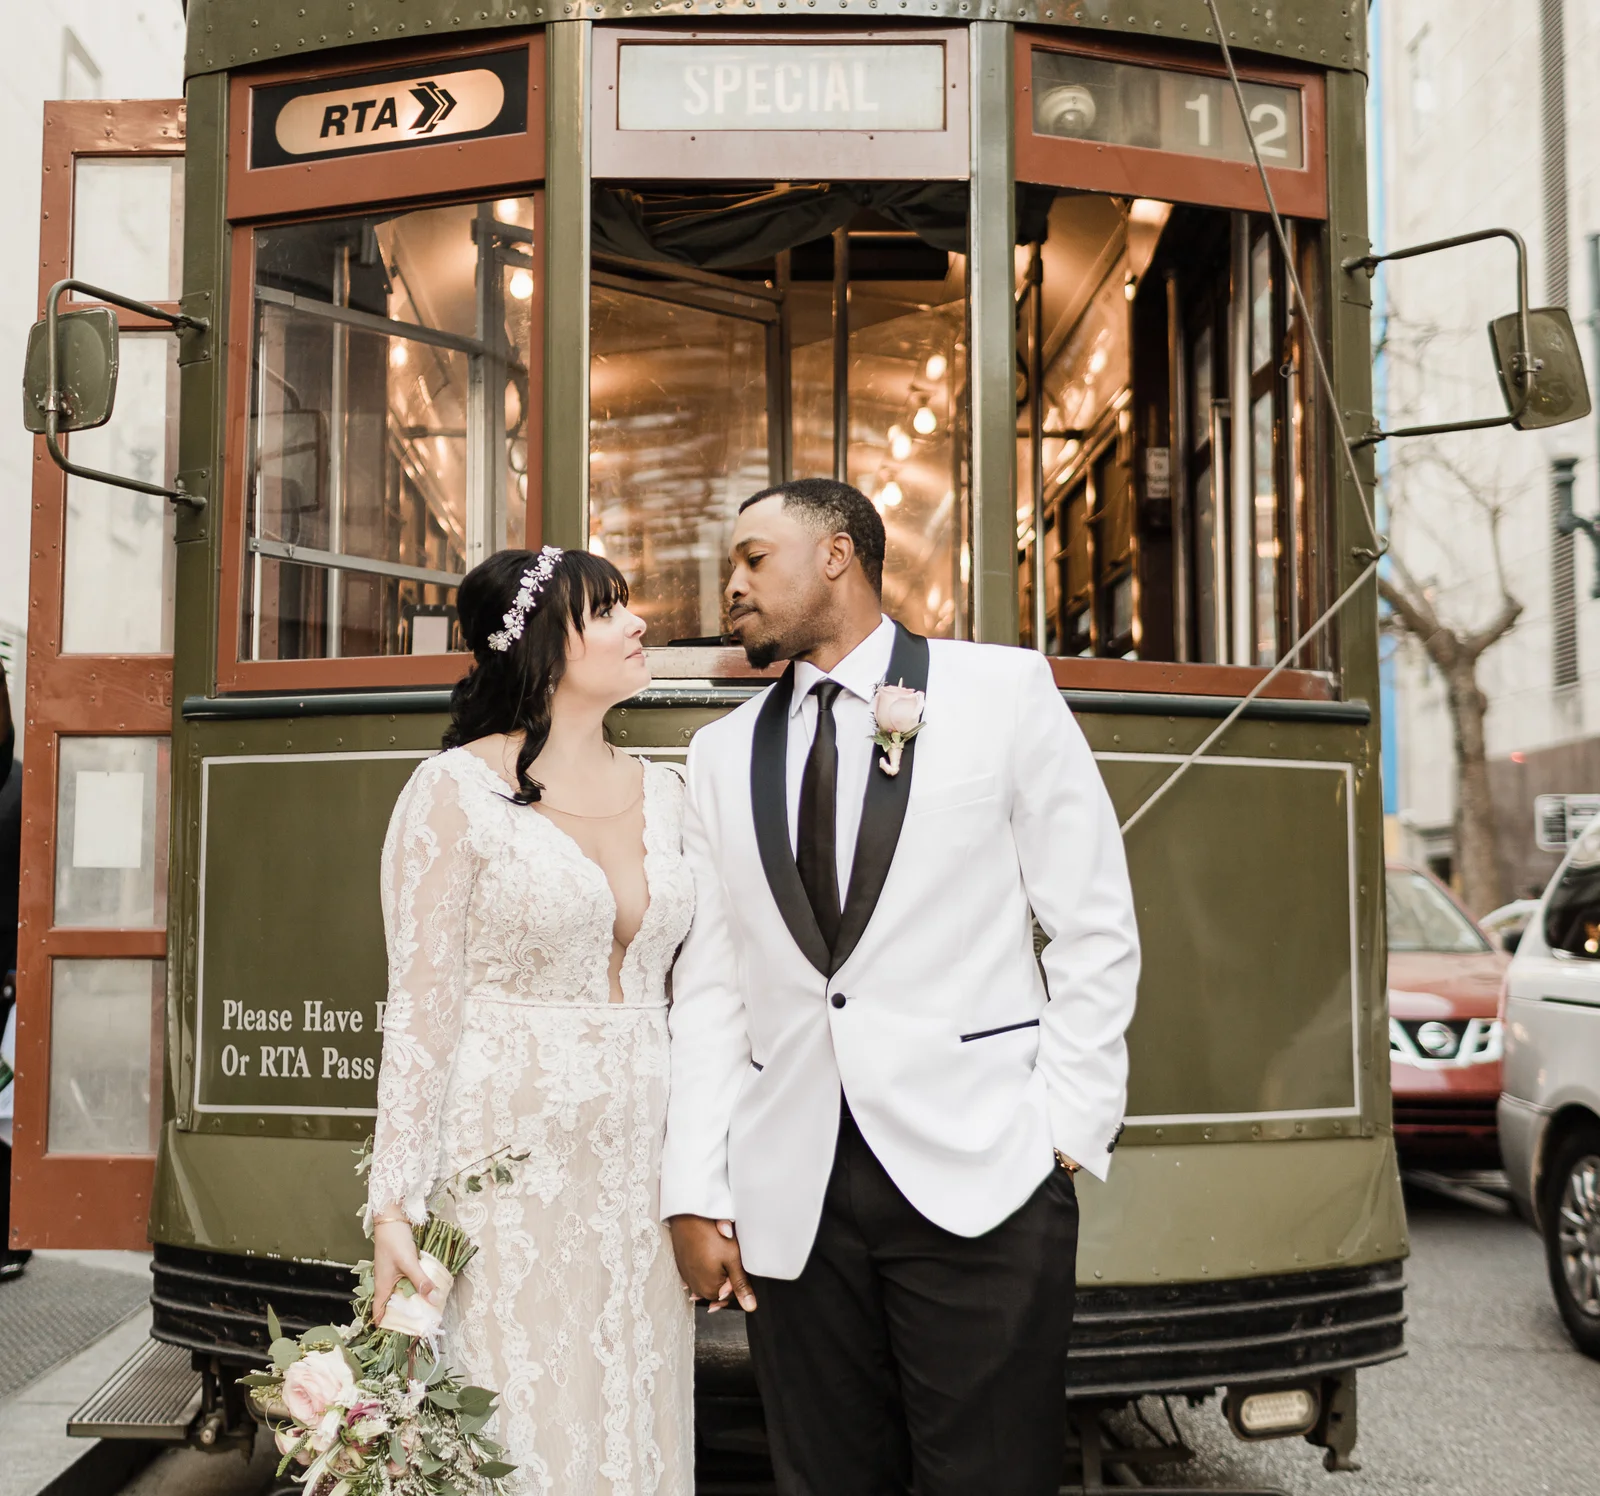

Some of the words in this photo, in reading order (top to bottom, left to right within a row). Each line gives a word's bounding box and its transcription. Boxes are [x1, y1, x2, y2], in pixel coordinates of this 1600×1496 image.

[682, 61, 880, 115] SPECIAL
[320, 97, 398, 138] RTA
[222, 999, 293, 1032] Please
[303, 1000, 363, 1033] Have
[221, 1044, 250, 1077] Or
[259, 1045, 312, 1078] RTA
[321, 1047, 375, 1080] Pass
